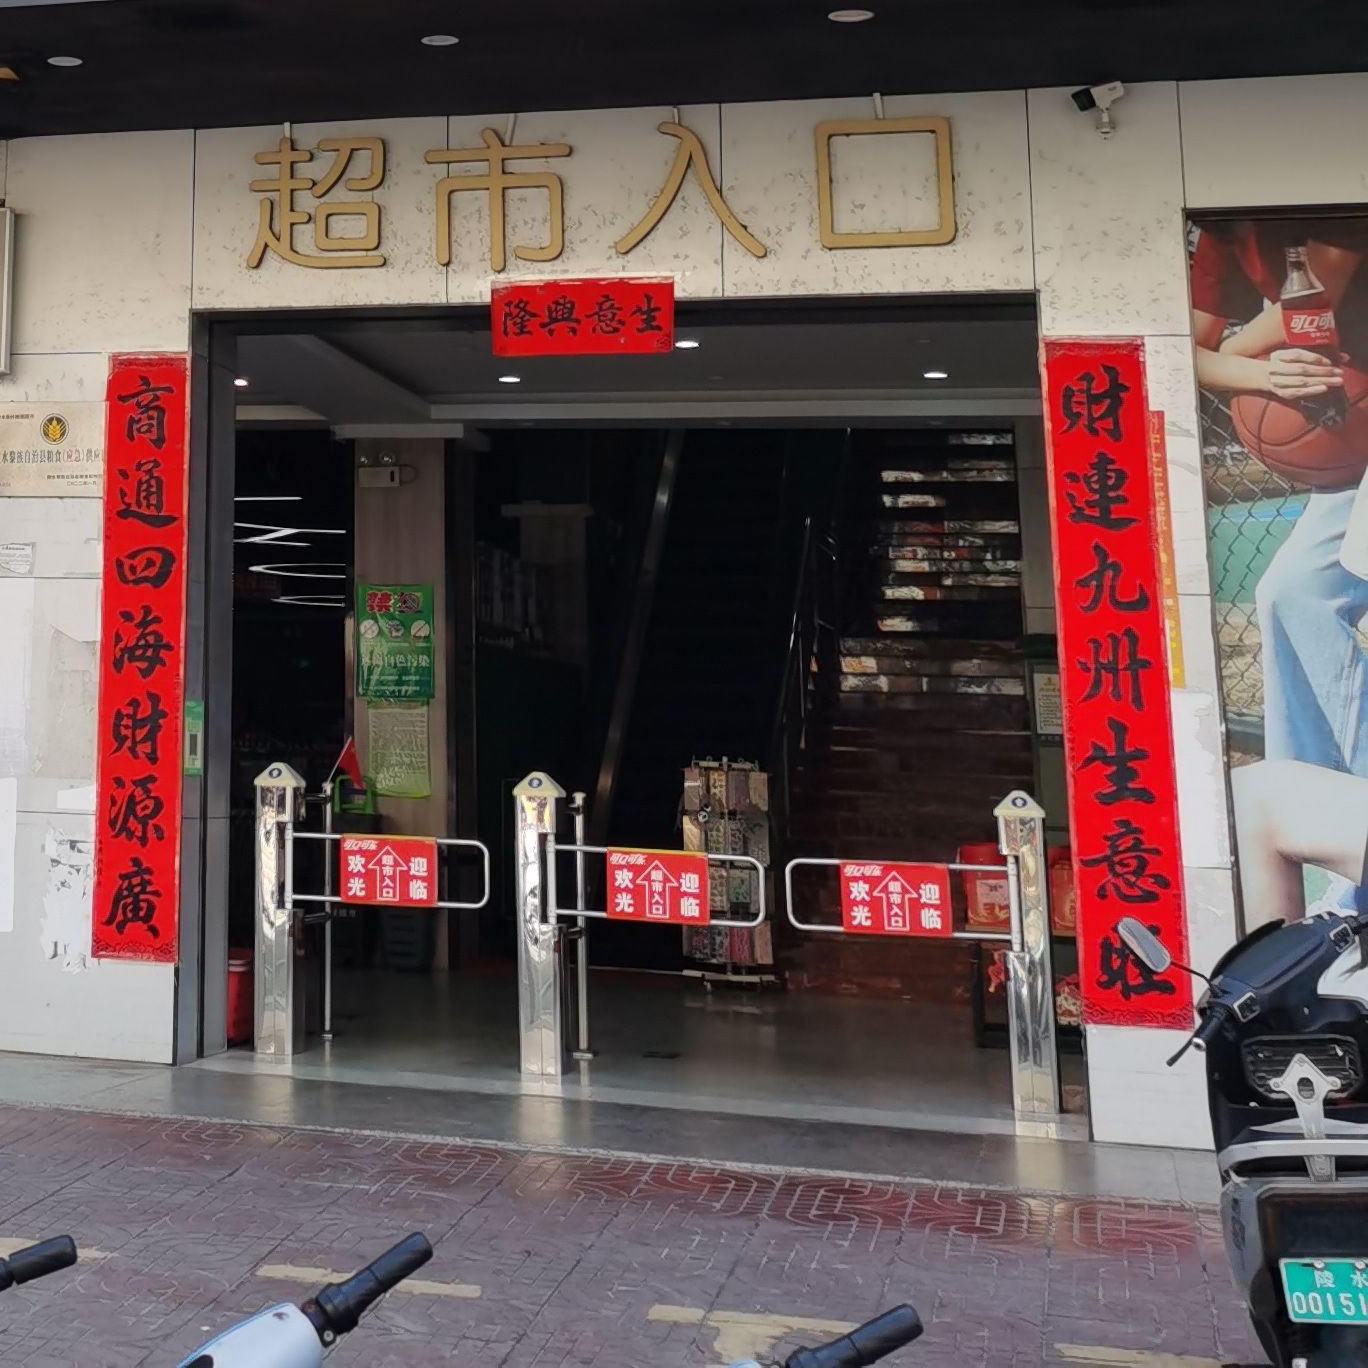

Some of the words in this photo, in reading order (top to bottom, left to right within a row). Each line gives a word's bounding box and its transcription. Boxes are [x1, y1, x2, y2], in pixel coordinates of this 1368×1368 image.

[247, 118, 957, 272] 超市入口
[100, 375, 179, 939] 商通四海財源廣
